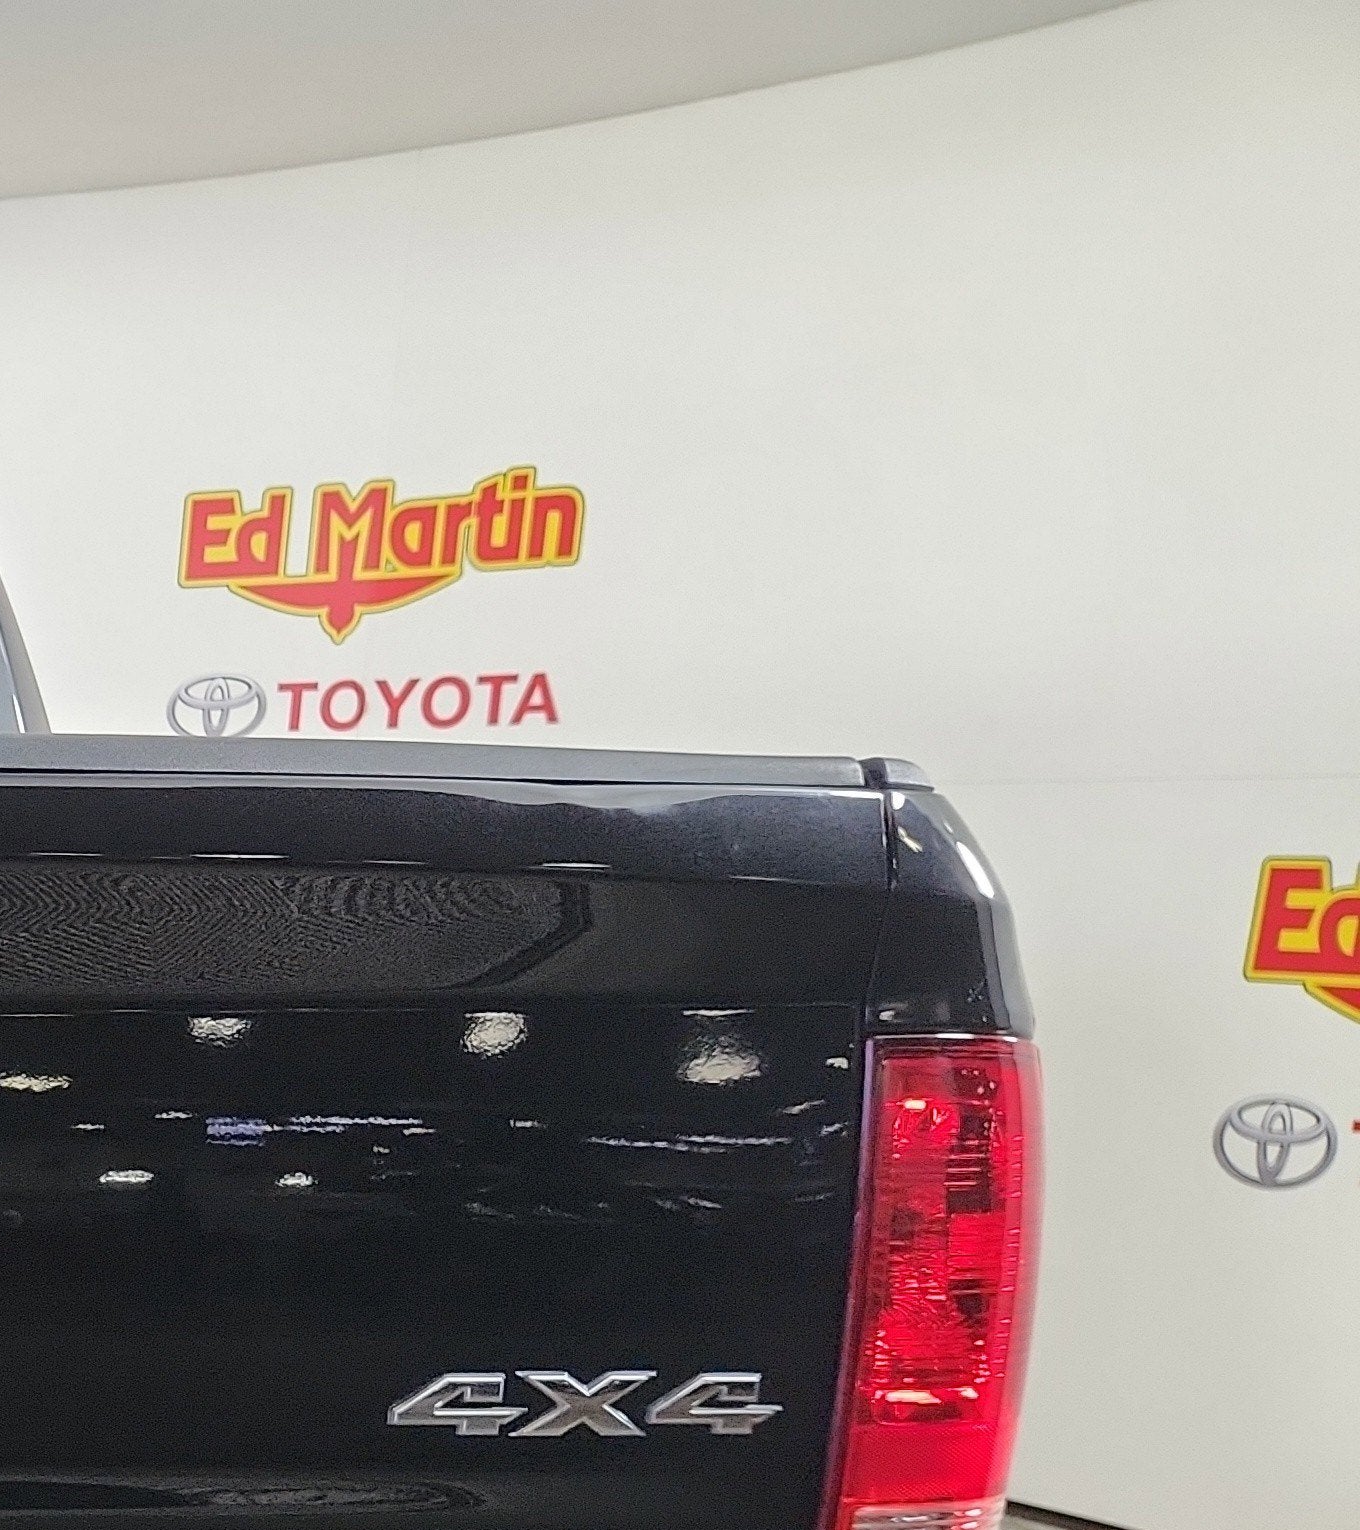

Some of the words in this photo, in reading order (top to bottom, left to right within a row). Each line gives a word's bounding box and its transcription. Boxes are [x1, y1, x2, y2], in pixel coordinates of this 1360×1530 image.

[181, 491, 291, 587] Ed
[308, 468, 583, 578] Martin
[278, 673, 559, 732] TOYOTA
[387, 1370, 783, 1437] 4X4
